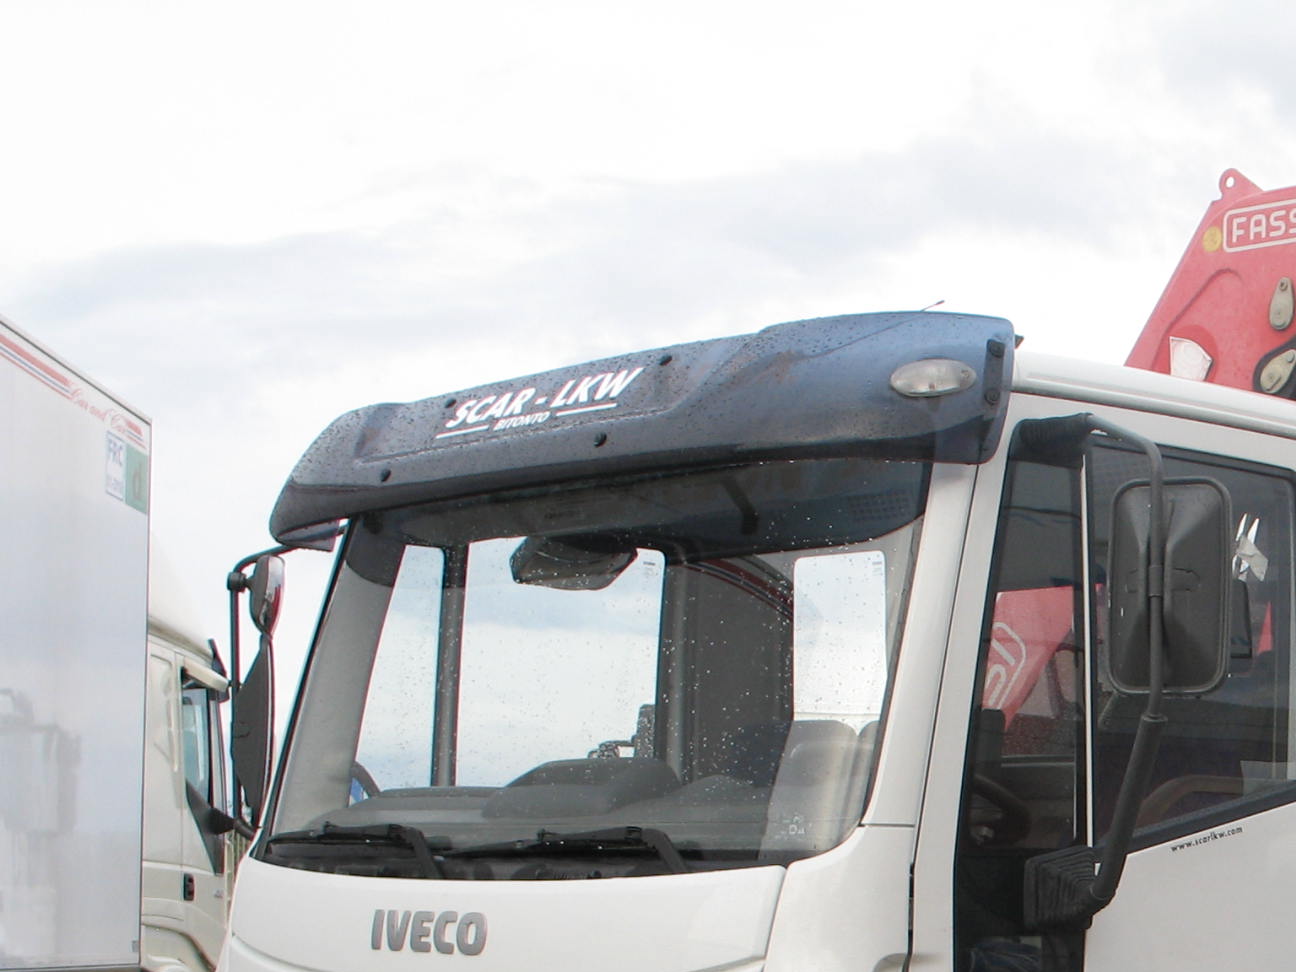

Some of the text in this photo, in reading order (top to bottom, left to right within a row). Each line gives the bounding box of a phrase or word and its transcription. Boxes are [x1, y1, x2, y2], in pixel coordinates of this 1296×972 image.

[445, 387, 537, 428] SCAR
[549, 367, 645, 408] LKW
[493, 411, 551, 431] BITONTO
[1171, 826, 1243, 853] www.scarlkw.com
[370, 908, 488, 956] IVECO
